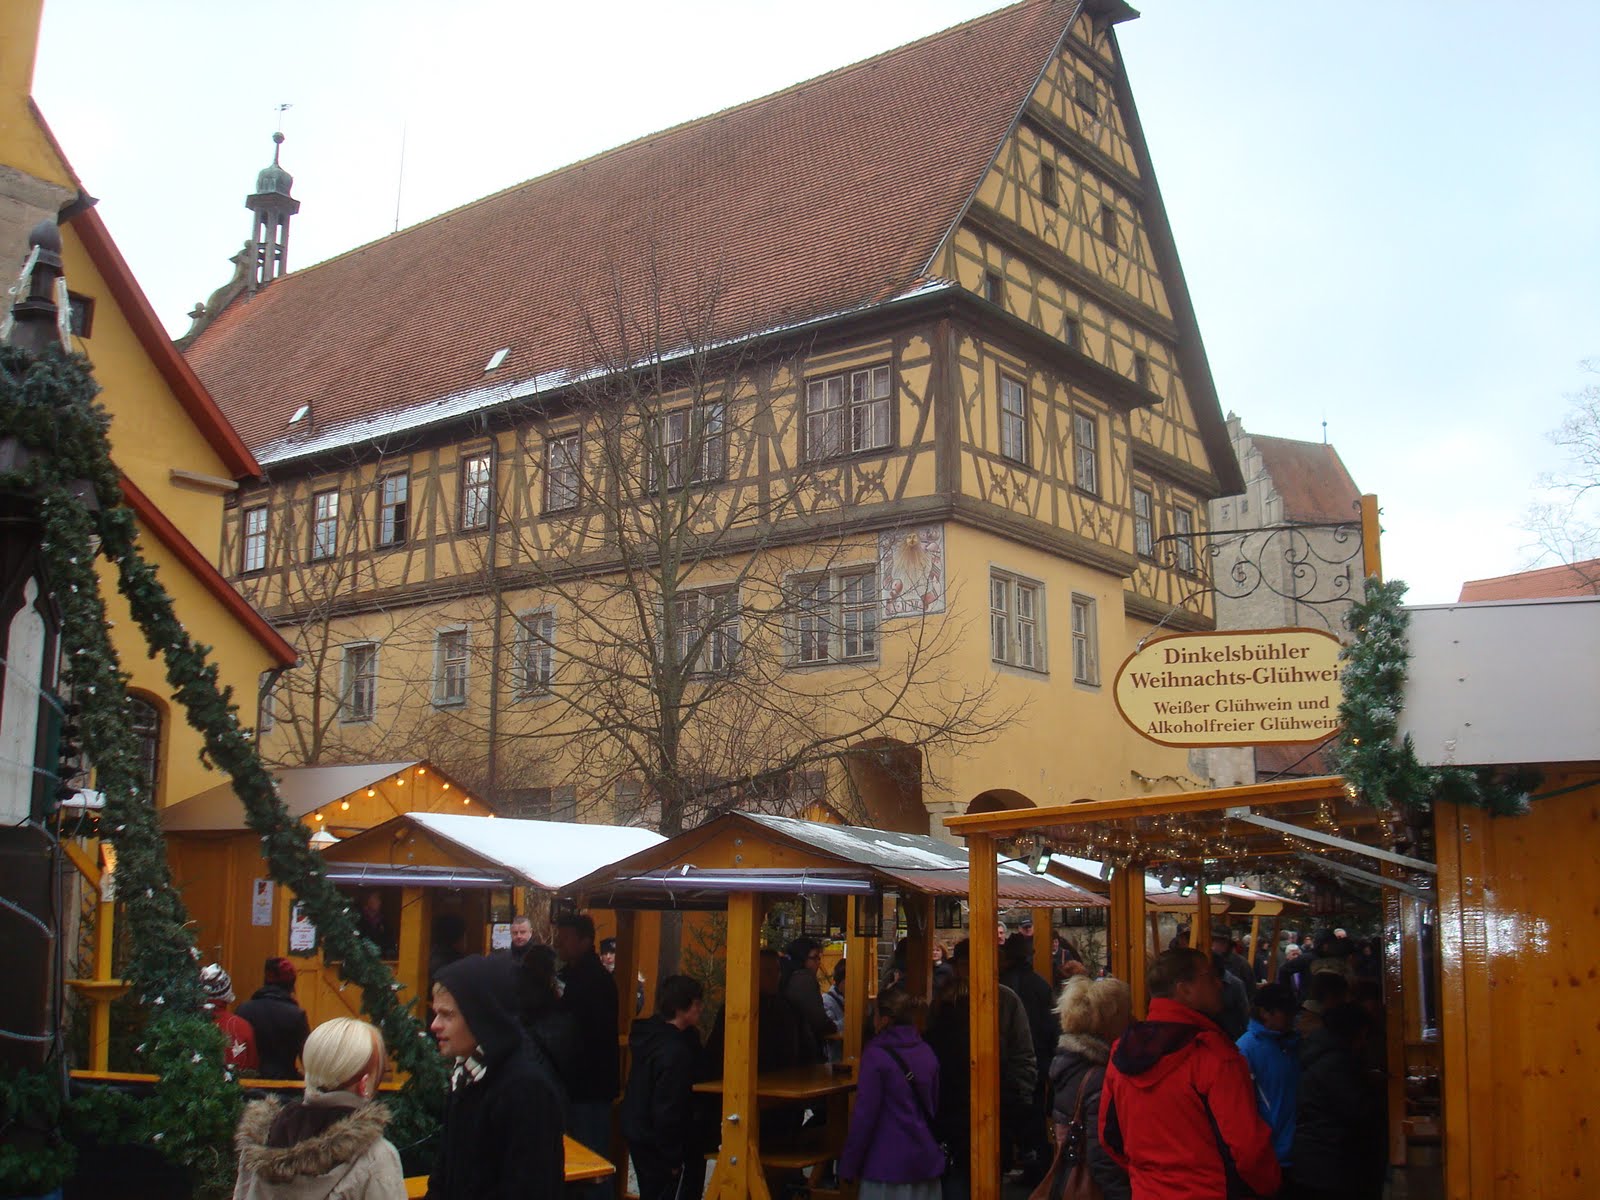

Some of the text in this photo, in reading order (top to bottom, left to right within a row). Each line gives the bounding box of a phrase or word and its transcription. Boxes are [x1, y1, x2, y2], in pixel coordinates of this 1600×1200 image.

[1164, 643, 1309, 664] Dinkelsbühler
[1130, 664, 1339, 688] Weihnachts-Glühwei
[1154, 696, 1329, 715] Weißer Glühwein und
[1147, 715, 1338, 734] Alkoholfreier Glühwein
